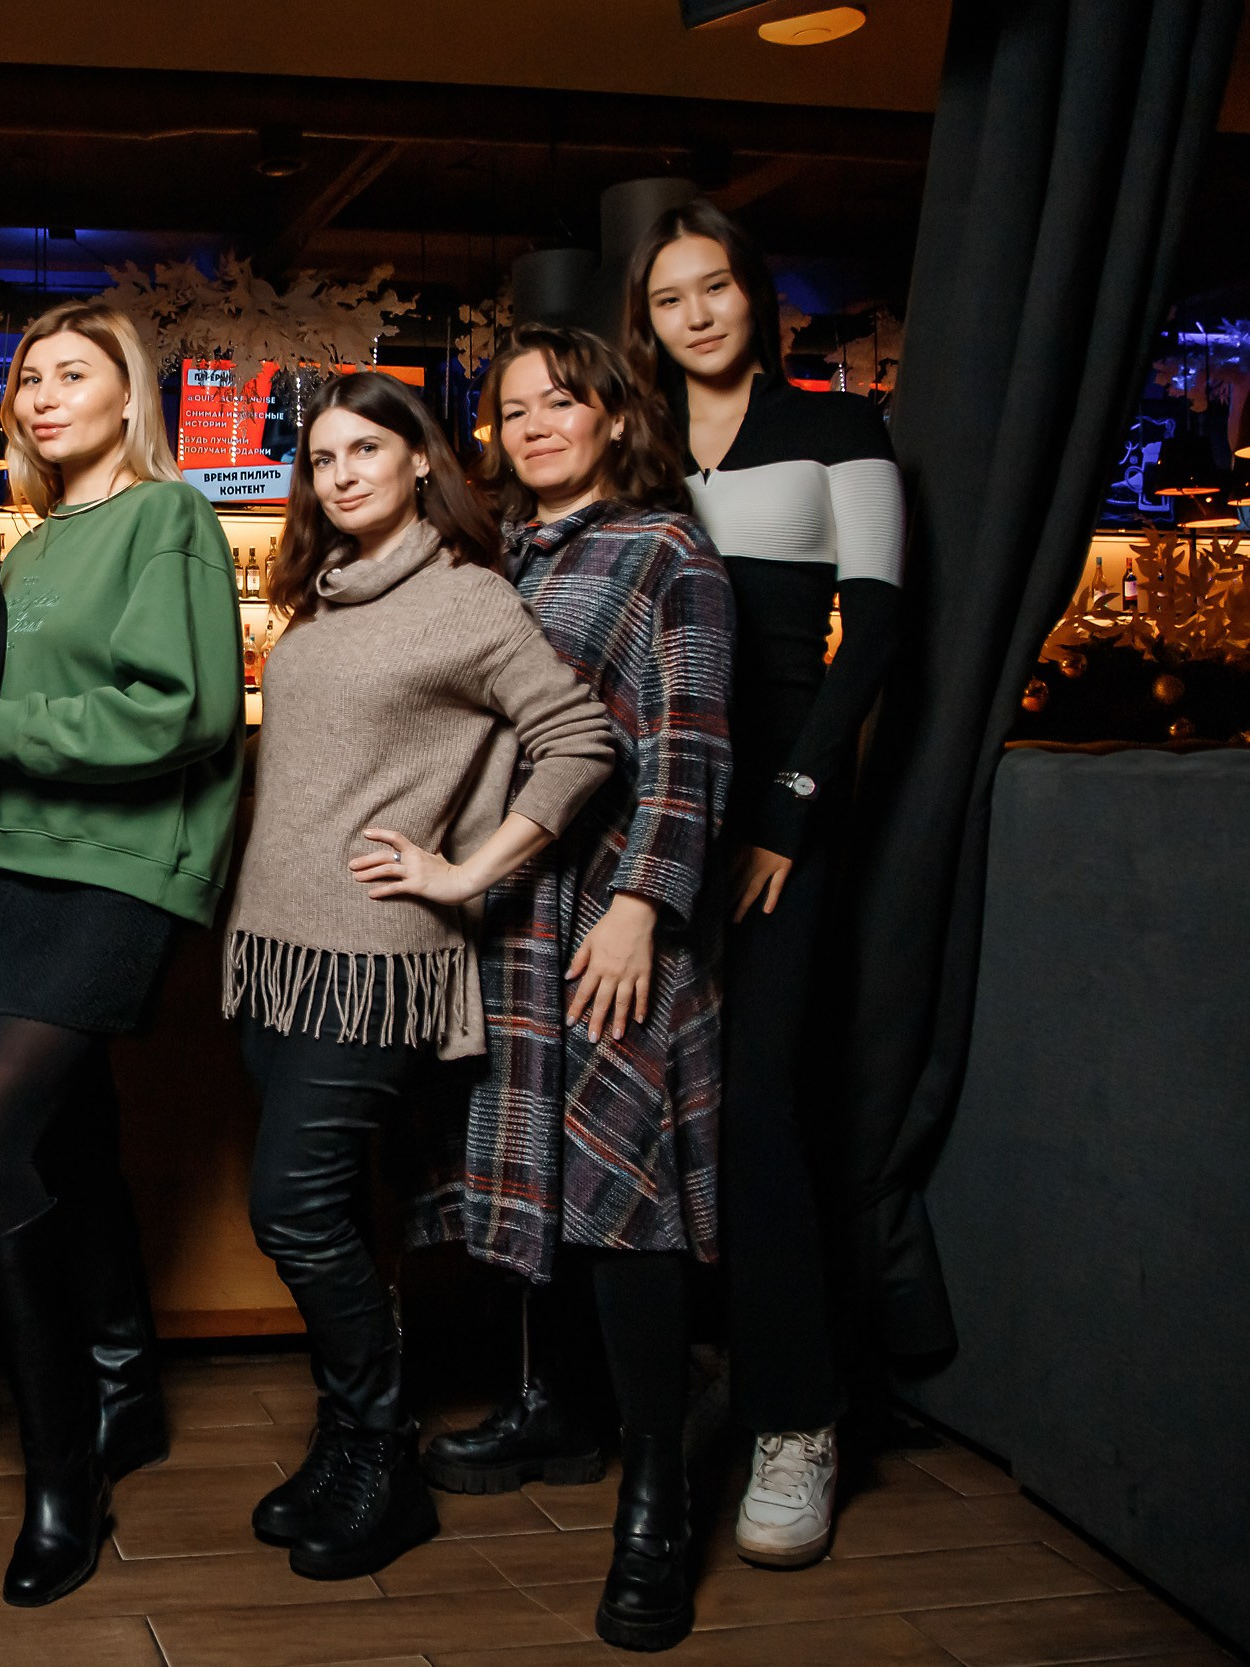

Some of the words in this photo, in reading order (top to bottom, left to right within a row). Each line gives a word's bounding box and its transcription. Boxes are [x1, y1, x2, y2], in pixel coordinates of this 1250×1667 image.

[185, 420, 227, 428] ИСТОРИИ
[184, 436, 208, 444] БУДЬ
[204, 471, 238, 482] ВРЕМЯ
[240, 470, 281, 480] ПИЛИТЬ
[220, 484, 266, 496] КОНТЕНТ
